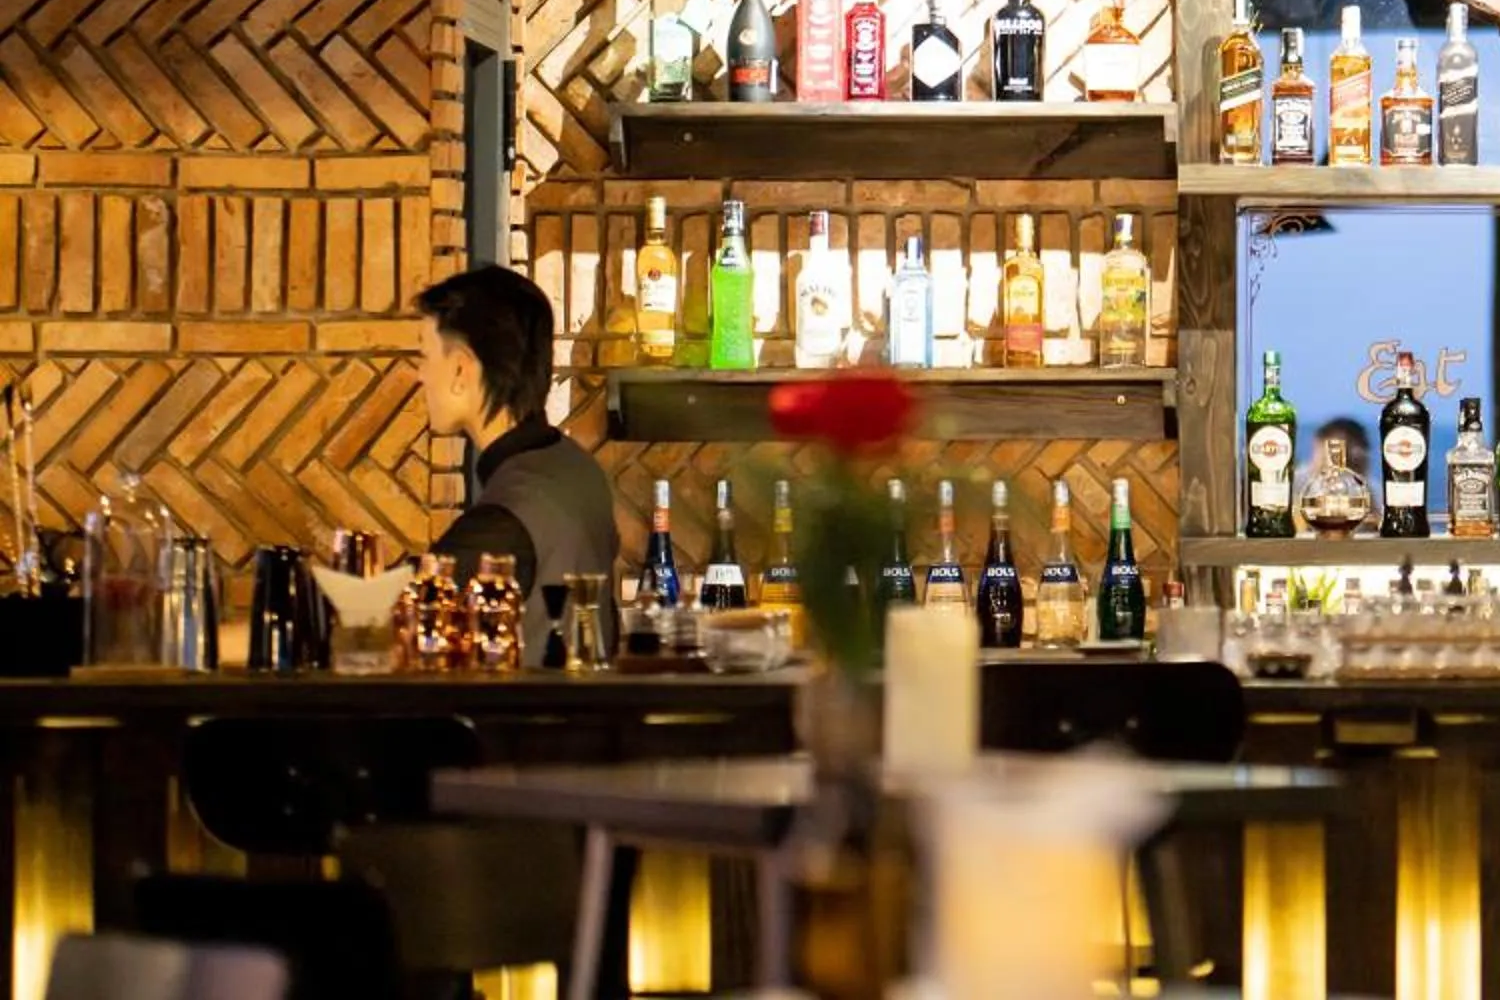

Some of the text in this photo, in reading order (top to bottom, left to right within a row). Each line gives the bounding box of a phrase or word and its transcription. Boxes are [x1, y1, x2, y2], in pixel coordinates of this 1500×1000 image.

[883, 567, 911, 577] BOLS
[931, 567, 959, 577] BOLS
[987, 567, 1015, 577] BOLS
[1111, 565, 1139, 575] BOLS
